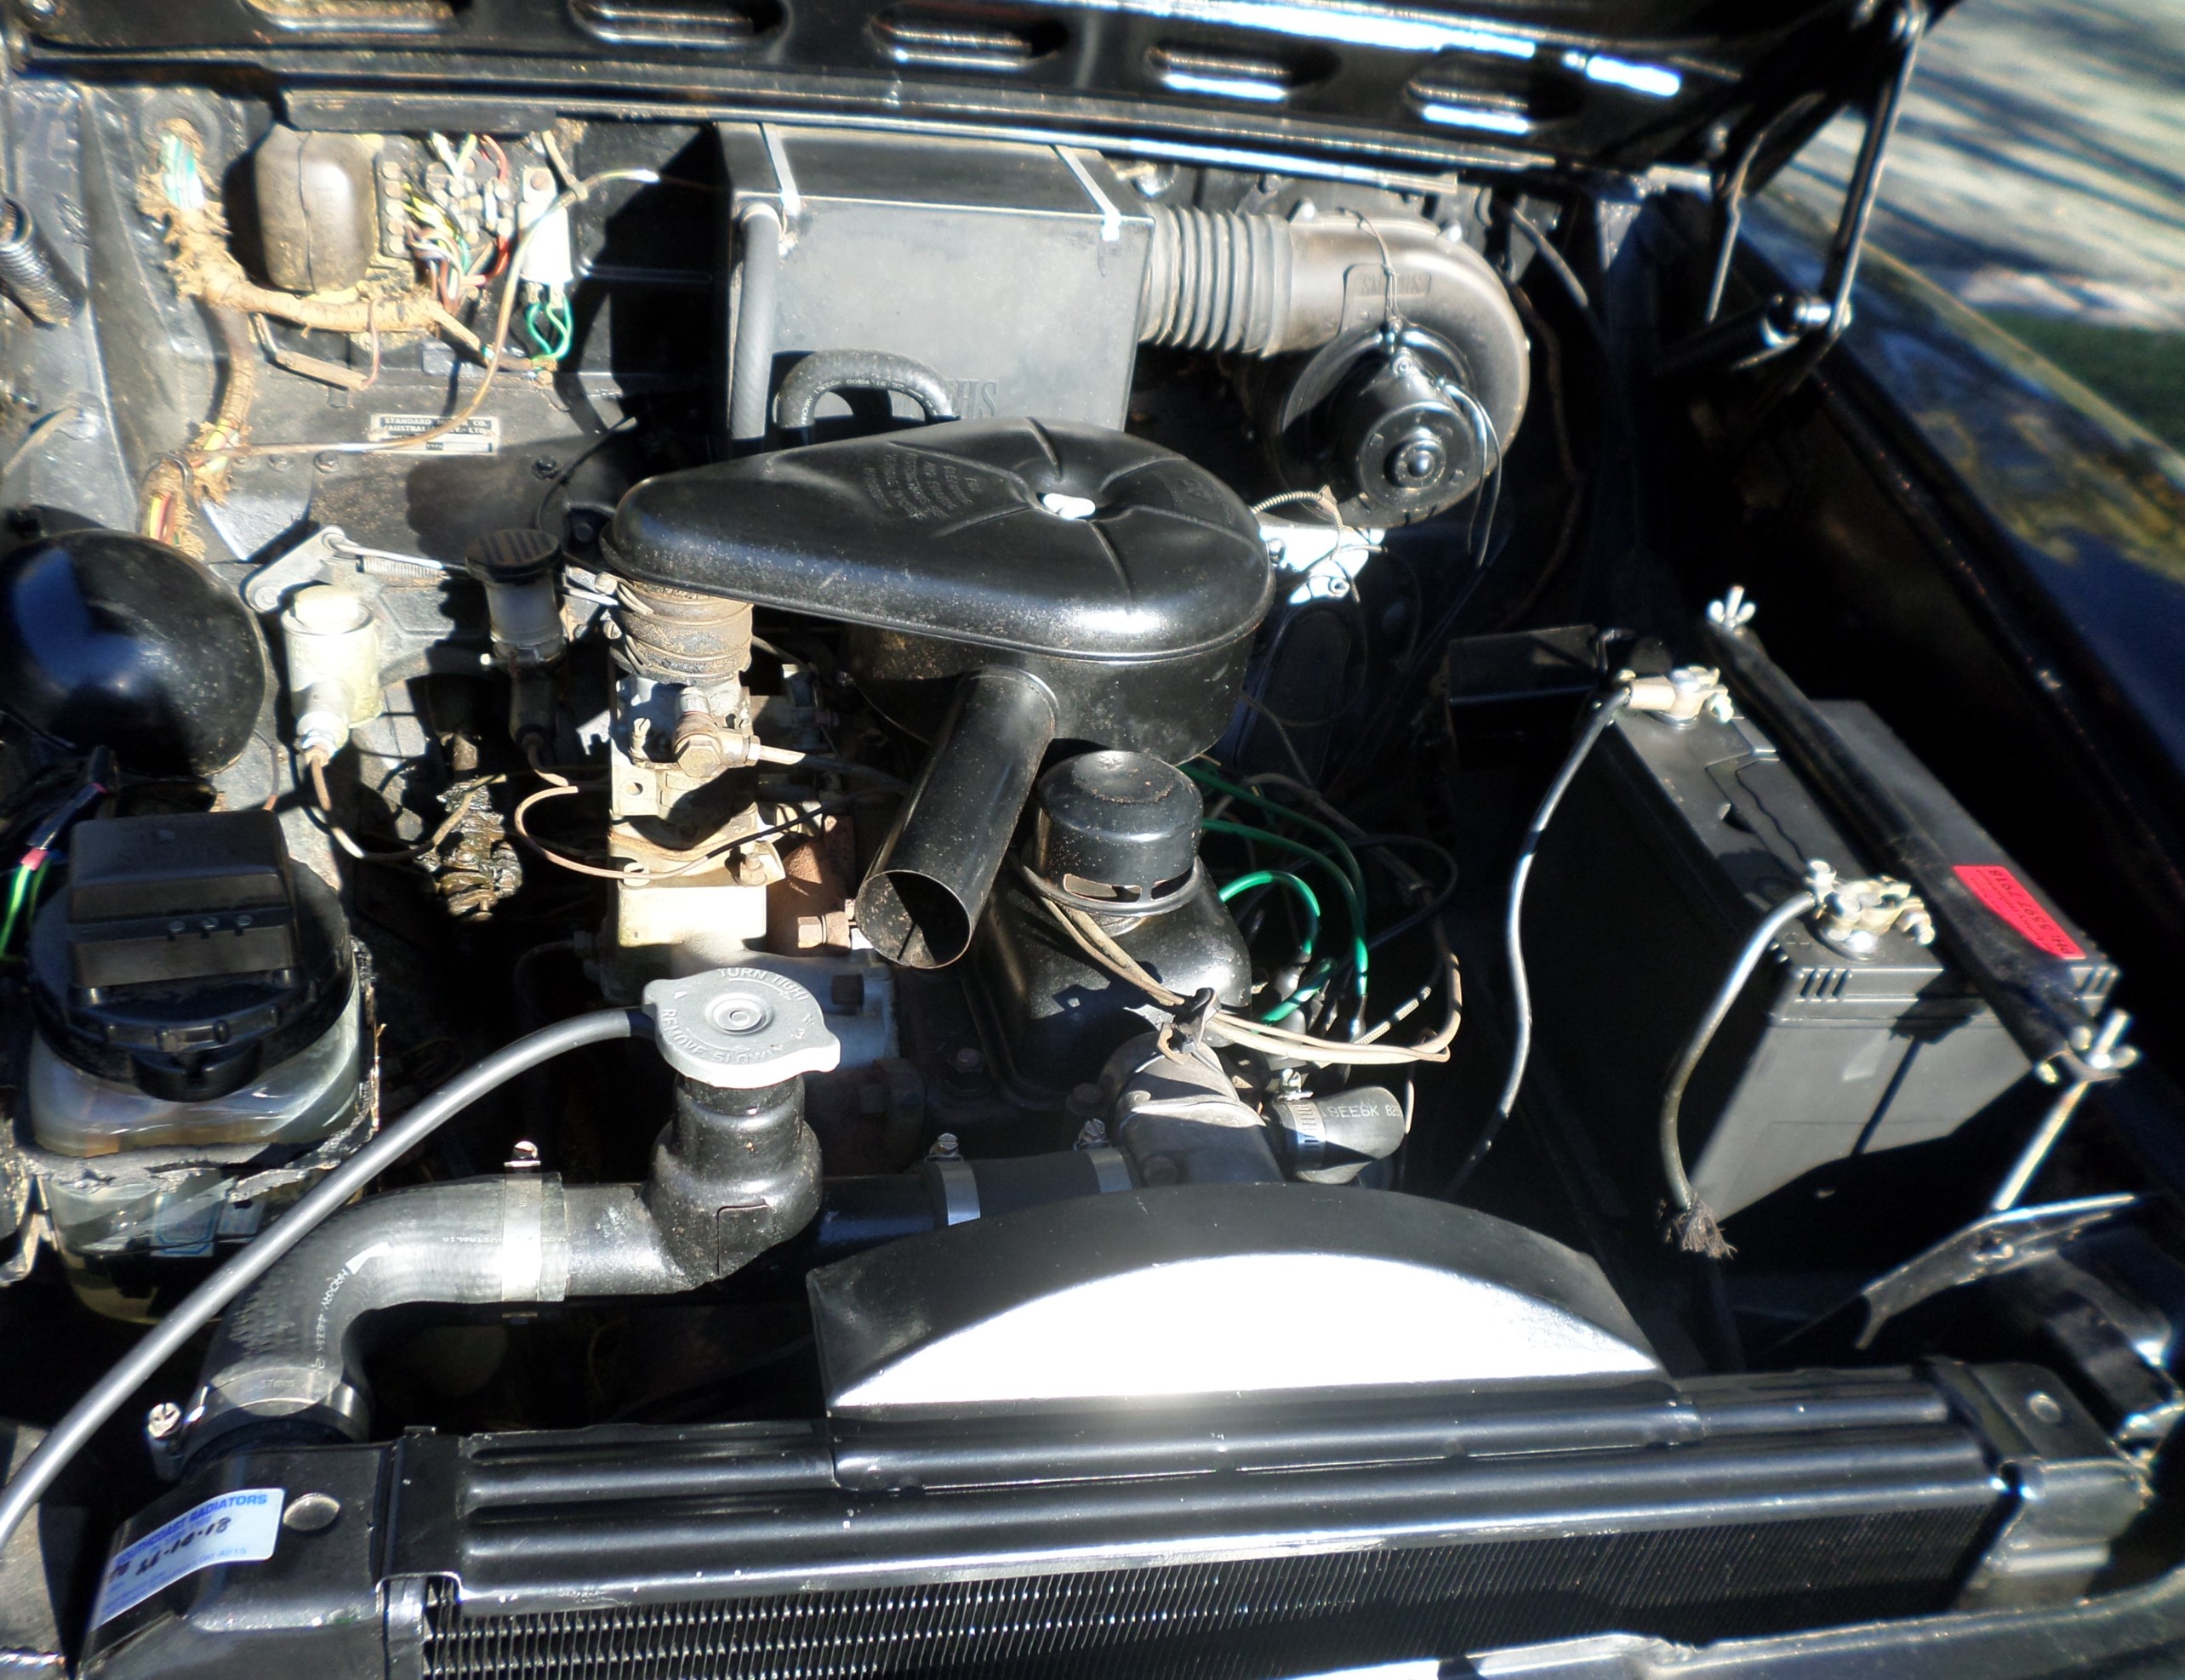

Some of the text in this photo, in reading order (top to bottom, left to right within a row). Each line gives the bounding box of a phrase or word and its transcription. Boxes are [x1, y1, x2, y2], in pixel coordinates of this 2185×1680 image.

[1361, 273, 1420, 295] SMHS
[720, 967, 767, 980] TURN
[661, 1008, 706, 1058] REMOVE
[189, 1493, 269, 1523] RADIATORS
